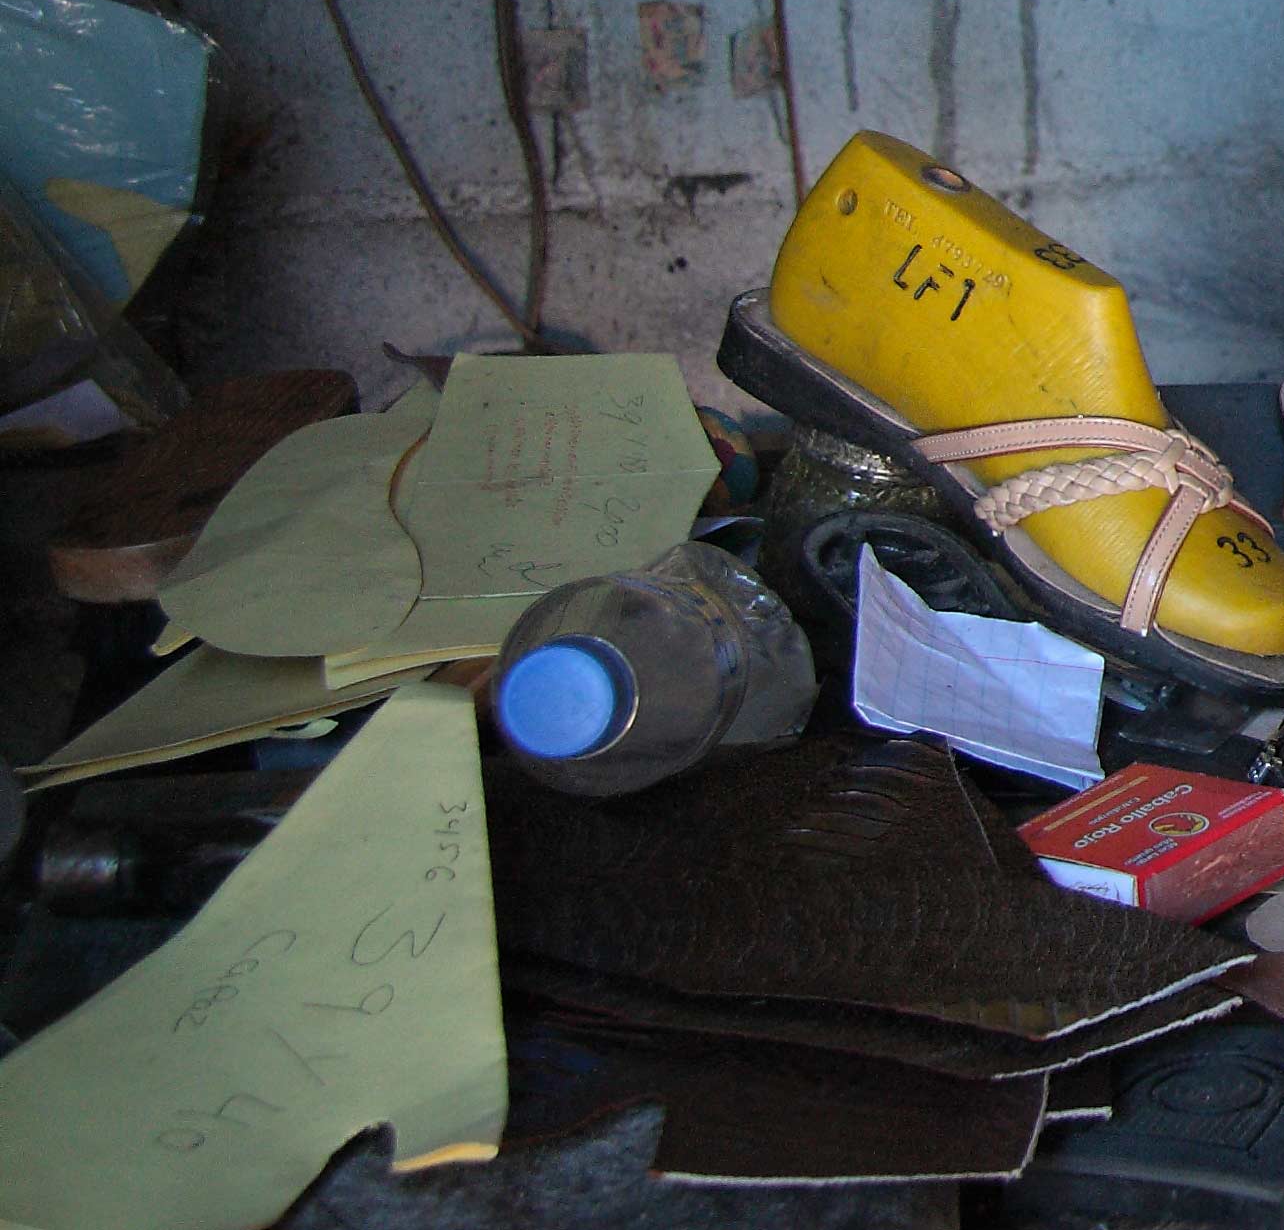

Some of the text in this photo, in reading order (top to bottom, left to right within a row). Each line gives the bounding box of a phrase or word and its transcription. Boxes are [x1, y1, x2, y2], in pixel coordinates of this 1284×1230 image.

[1215, 530, 1272, 569] 33
[1122, 783, 1194, 824] Caballo
[424, 800, 470, 883] 3456
[1073, 818, 1122, 849] Rojo
